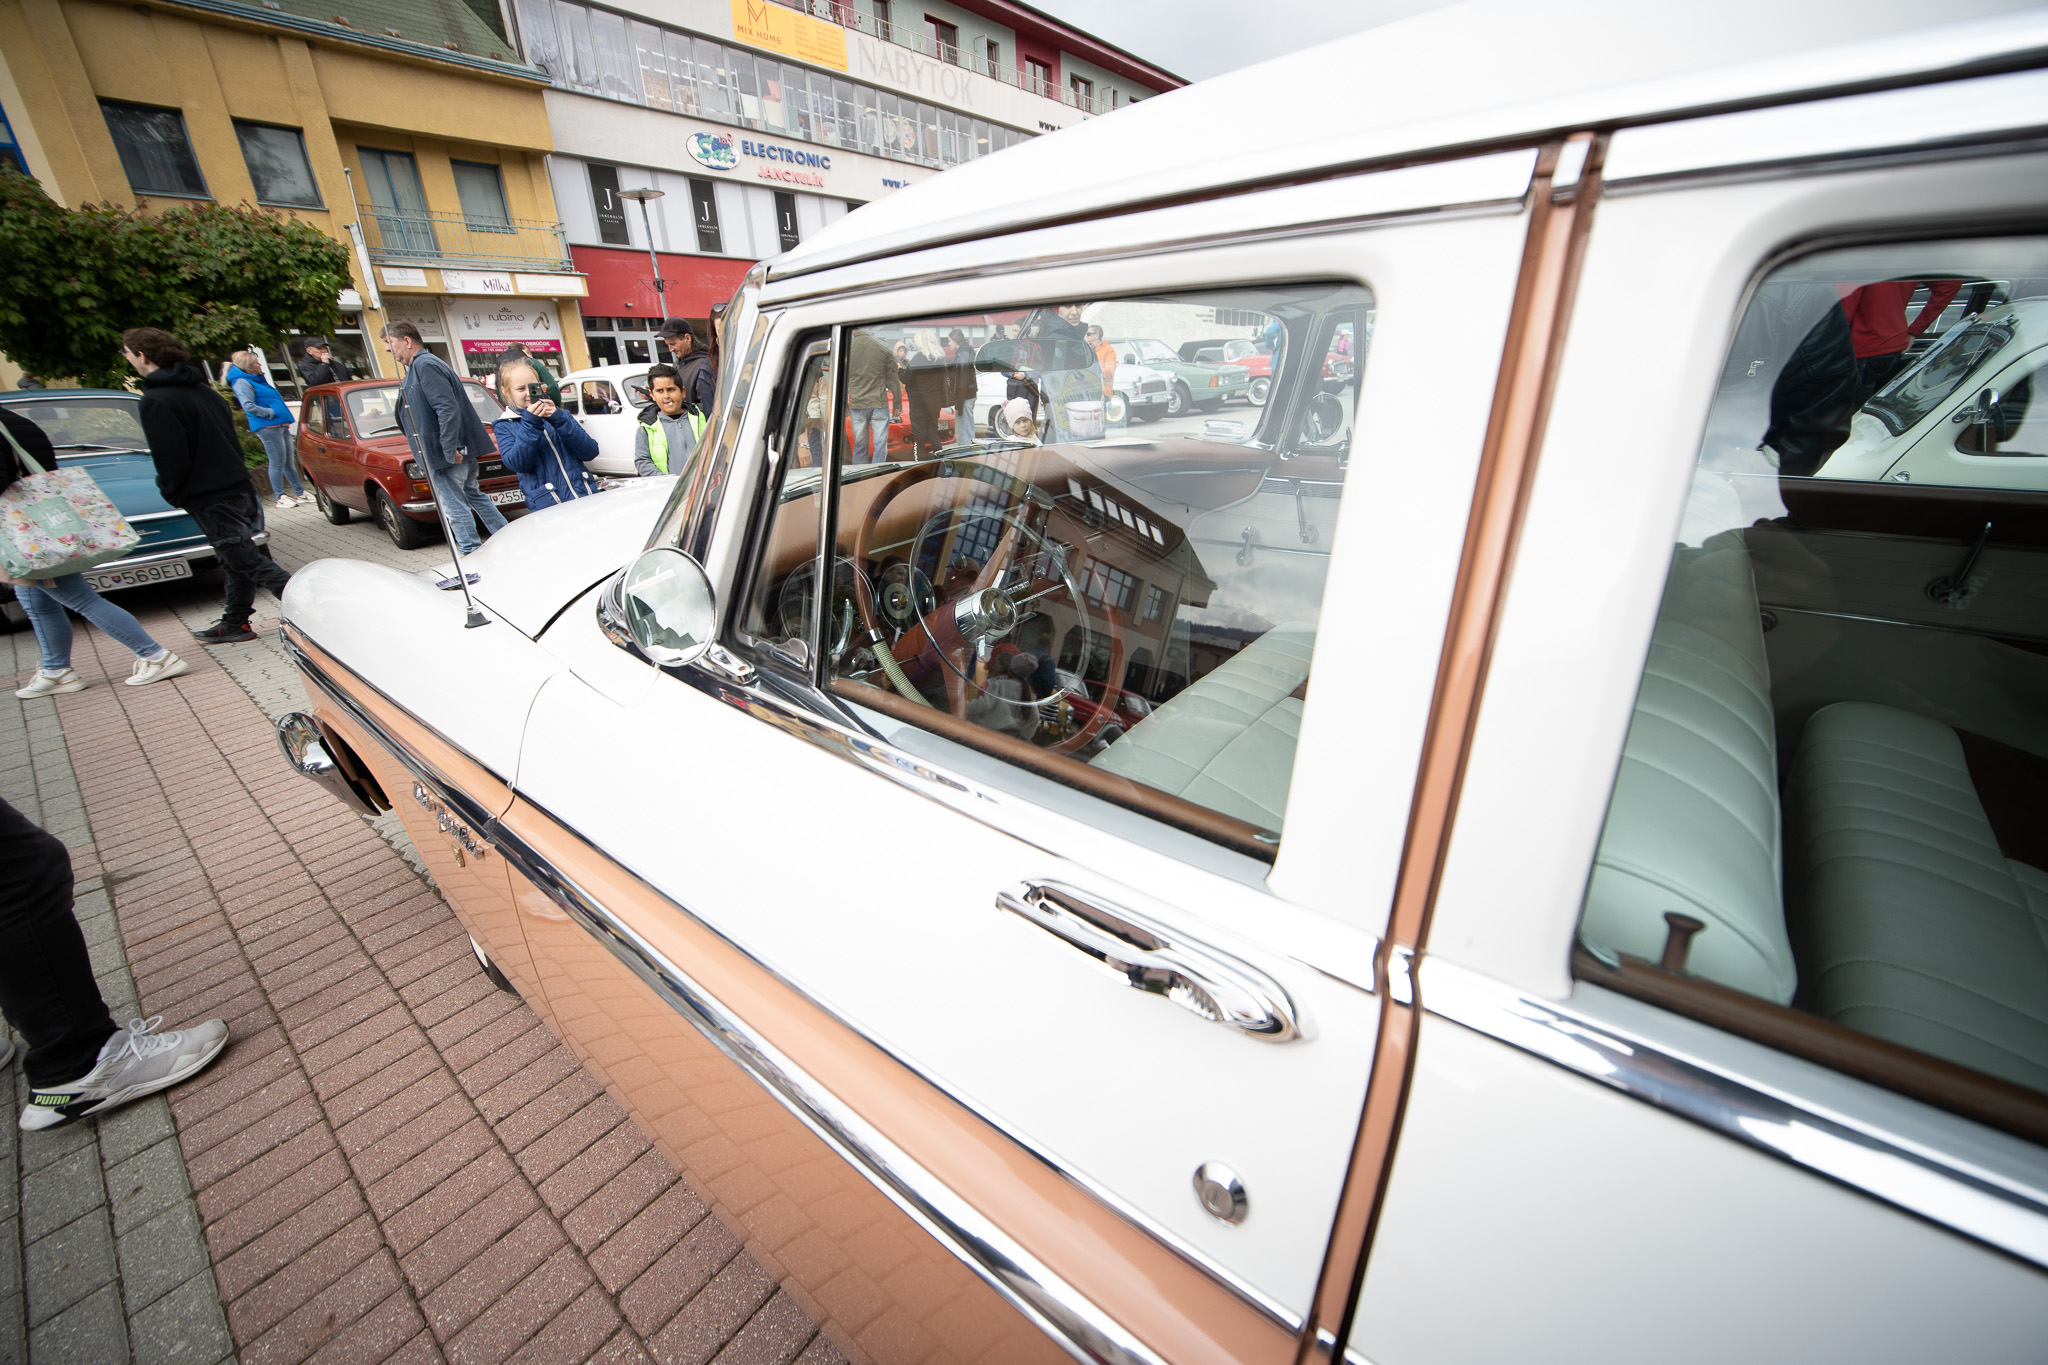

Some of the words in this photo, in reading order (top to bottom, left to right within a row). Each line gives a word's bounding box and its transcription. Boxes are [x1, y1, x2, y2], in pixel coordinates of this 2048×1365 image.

[736, 24, 754, 35] MIX
[756, 31, 782, 45] HOME
[741, 140, 831, 170] ELECTRONIC
[603, 188, 613, 211] J
[701, 201, 710, 222] J
[783, 212, 791, 231] J
[482, 278, 511, 293] Milka
[487, 313, 525, 322] rubino
[123, 563, 187, 585] 569ED
[34, 1095, 71, 1105] PUMA
